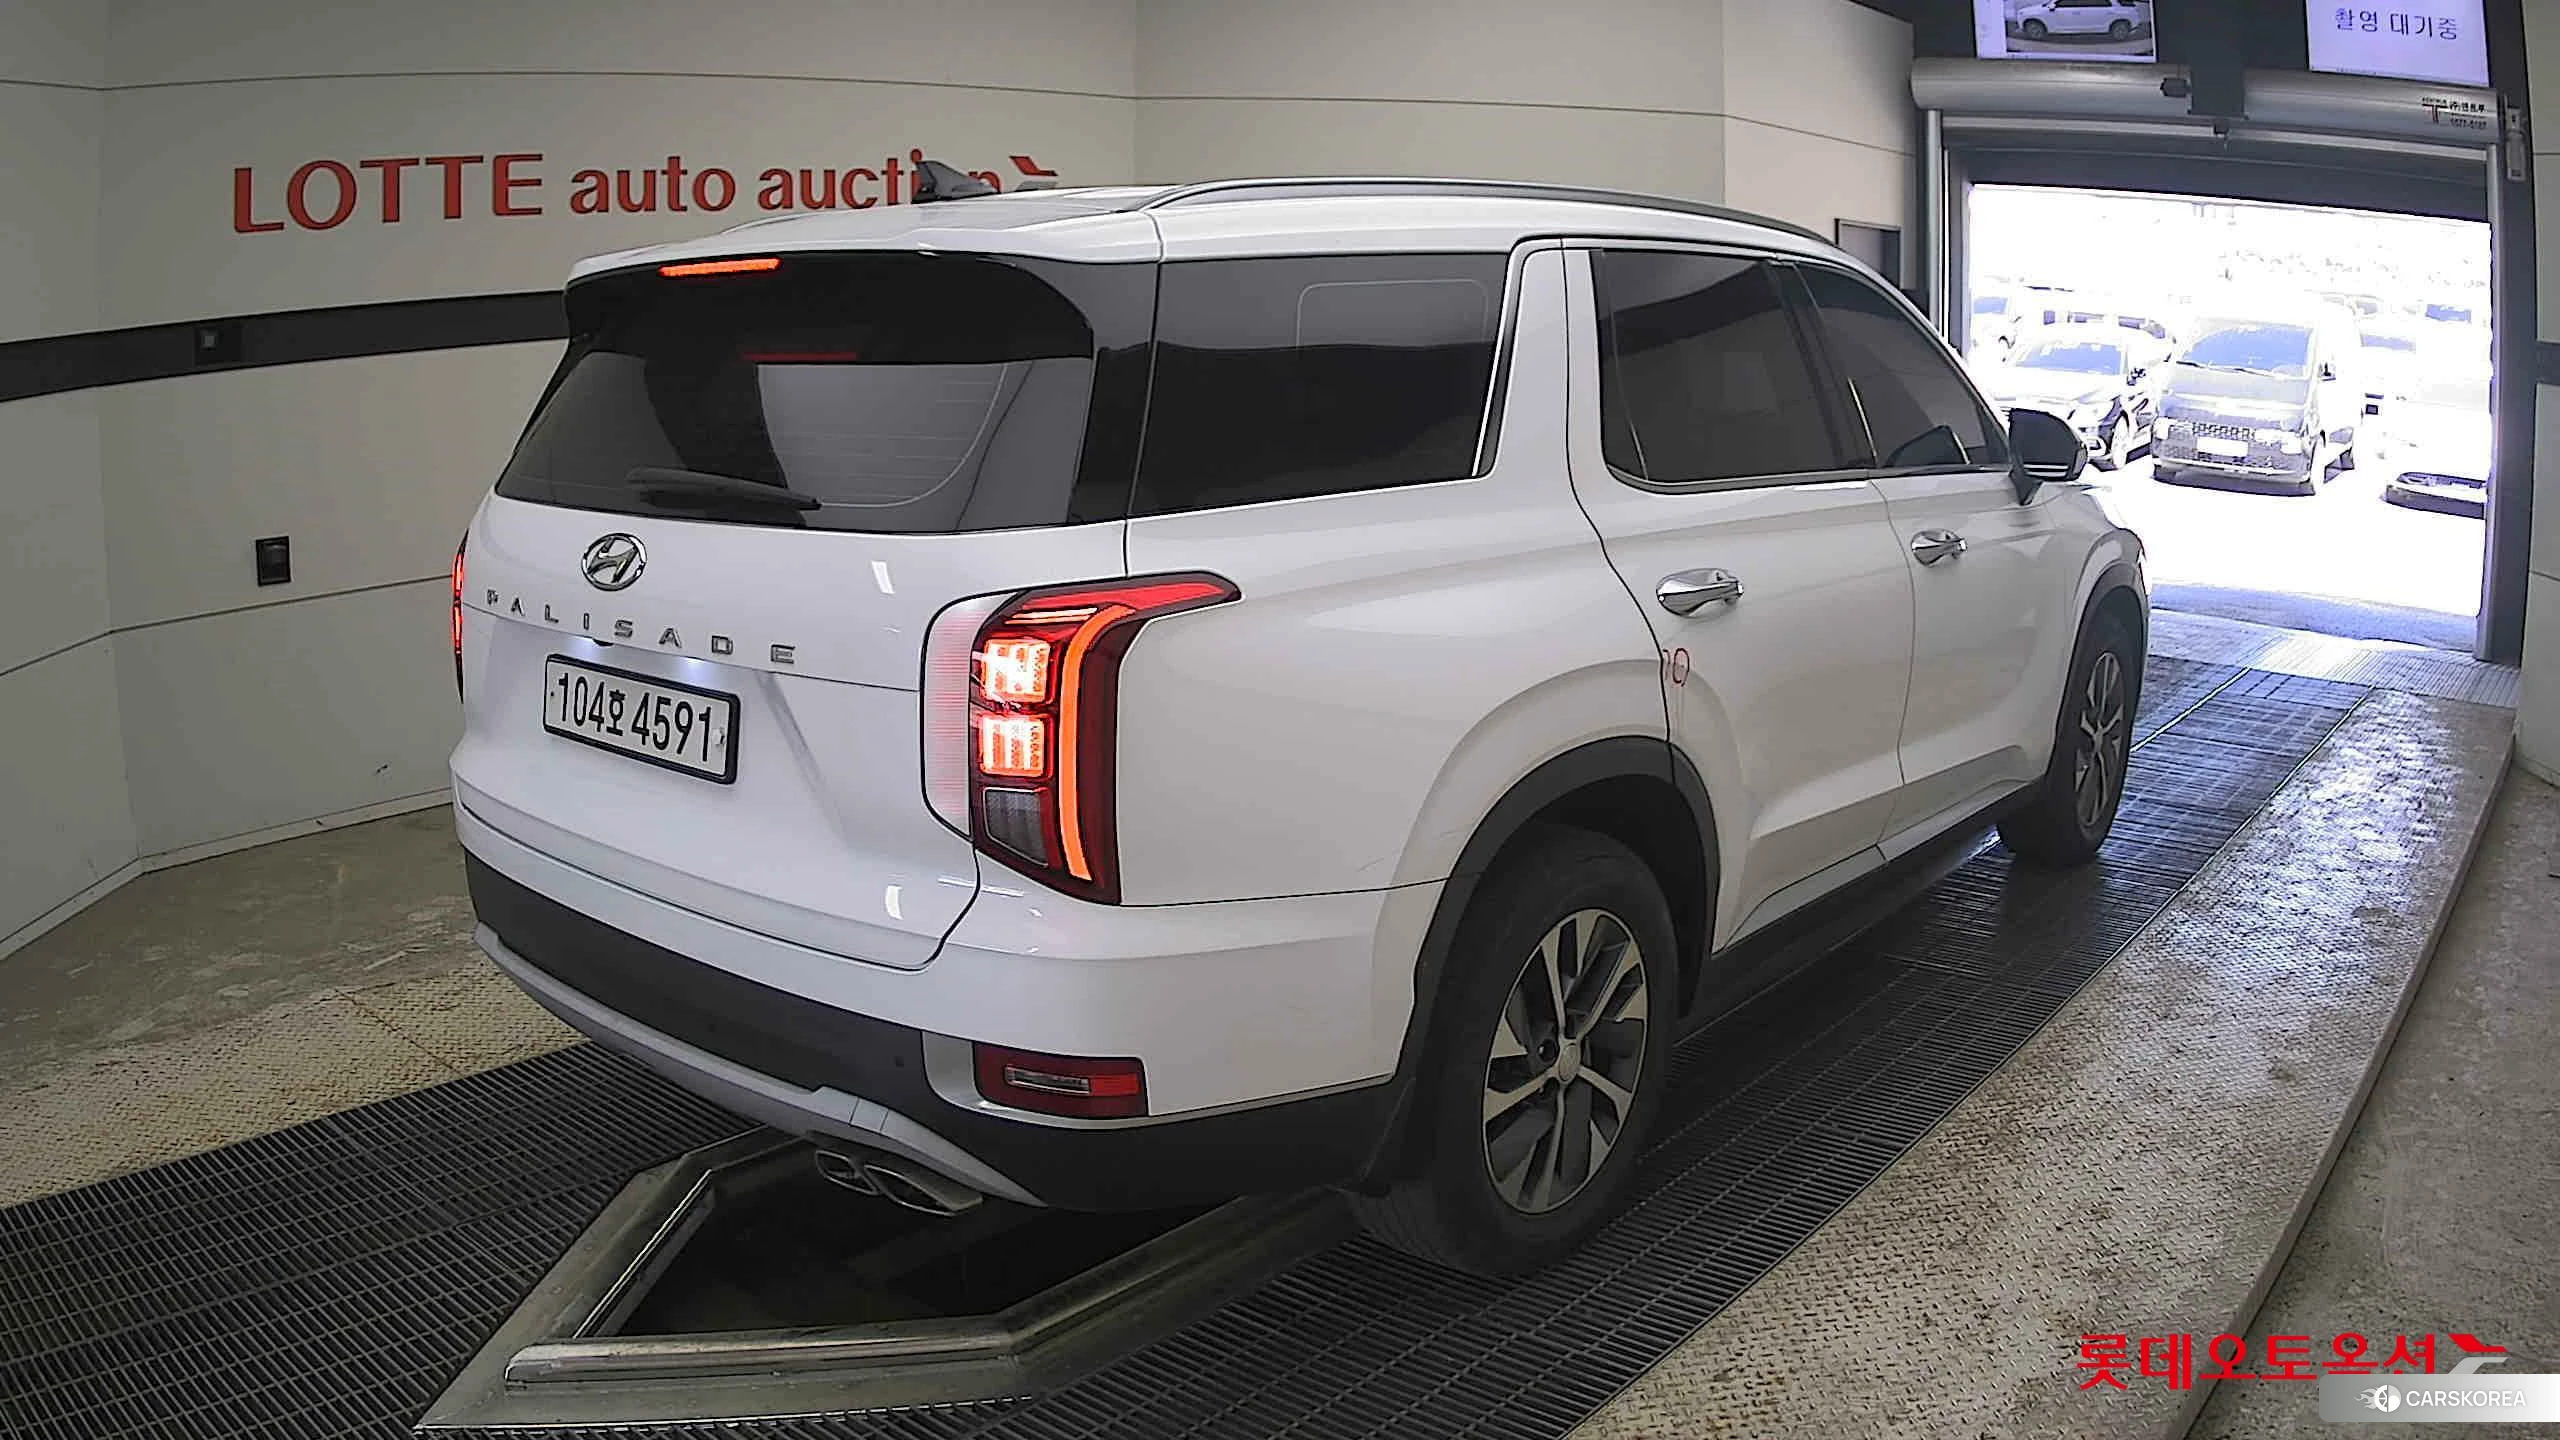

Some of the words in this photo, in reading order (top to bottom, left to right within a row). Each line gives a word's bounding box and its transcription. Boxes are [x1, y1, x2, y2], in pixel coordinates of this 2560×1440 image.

[2335, 8, 2379, 33] 촬영
[2390, 12, 2457, 40] 대기중
[233, 153, 543, 233] LOTTE
[569, 156, 737, 214] auto
[757, 148, 1002, 211] auctin
[486, 589, 796, 665] PALISADE
